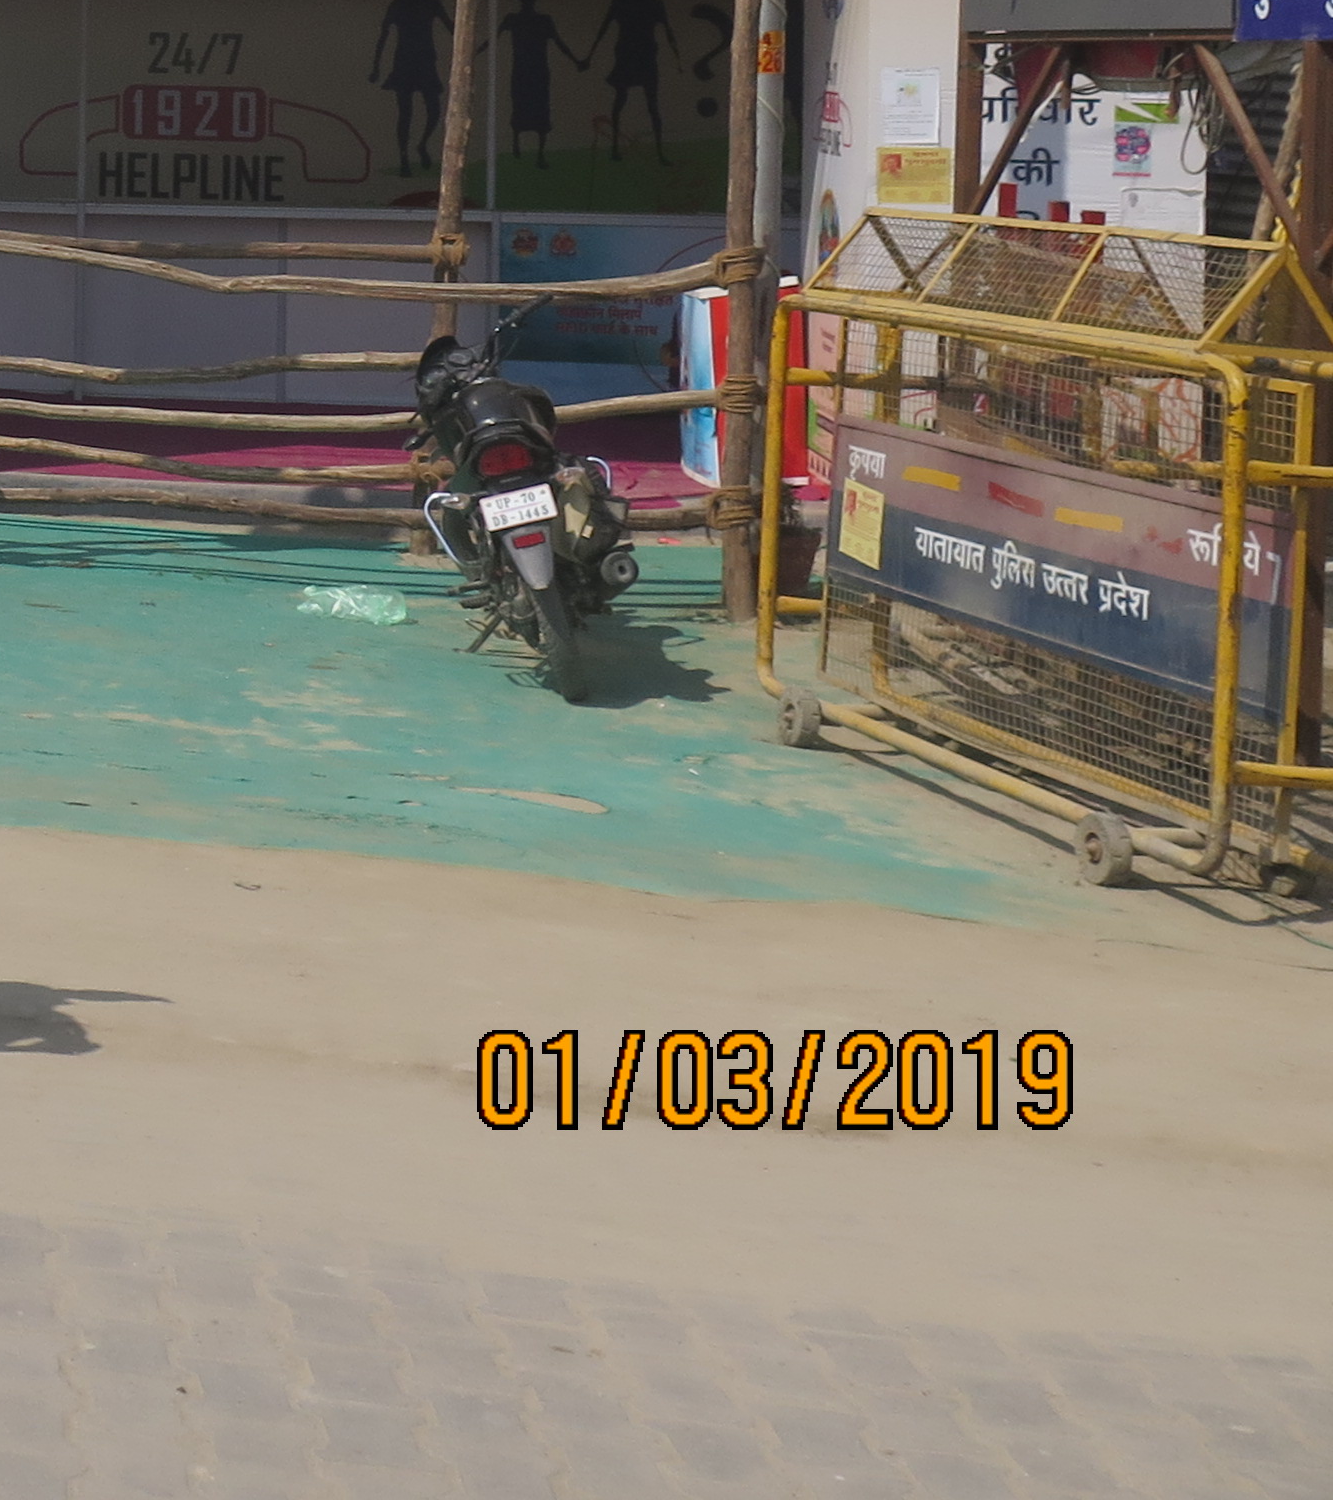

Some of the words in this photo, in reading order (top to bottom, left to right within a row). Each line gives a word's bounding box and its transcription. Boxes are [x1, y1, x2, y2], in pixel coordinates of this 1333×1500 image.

[148, 32, 243, 74] 24/7
[132, 90, 256, 138] 1920
[99, 152, 285, 202] HELPLINE
[1010, 147, 1060, 186] की
[914, 526, 986, 574] यातायात
[992, 540, 1036, 589] पुलिस
[1042, 562, 1089, 606] उत्तर
[1098, 571, 1151, 621] प्रदेश
